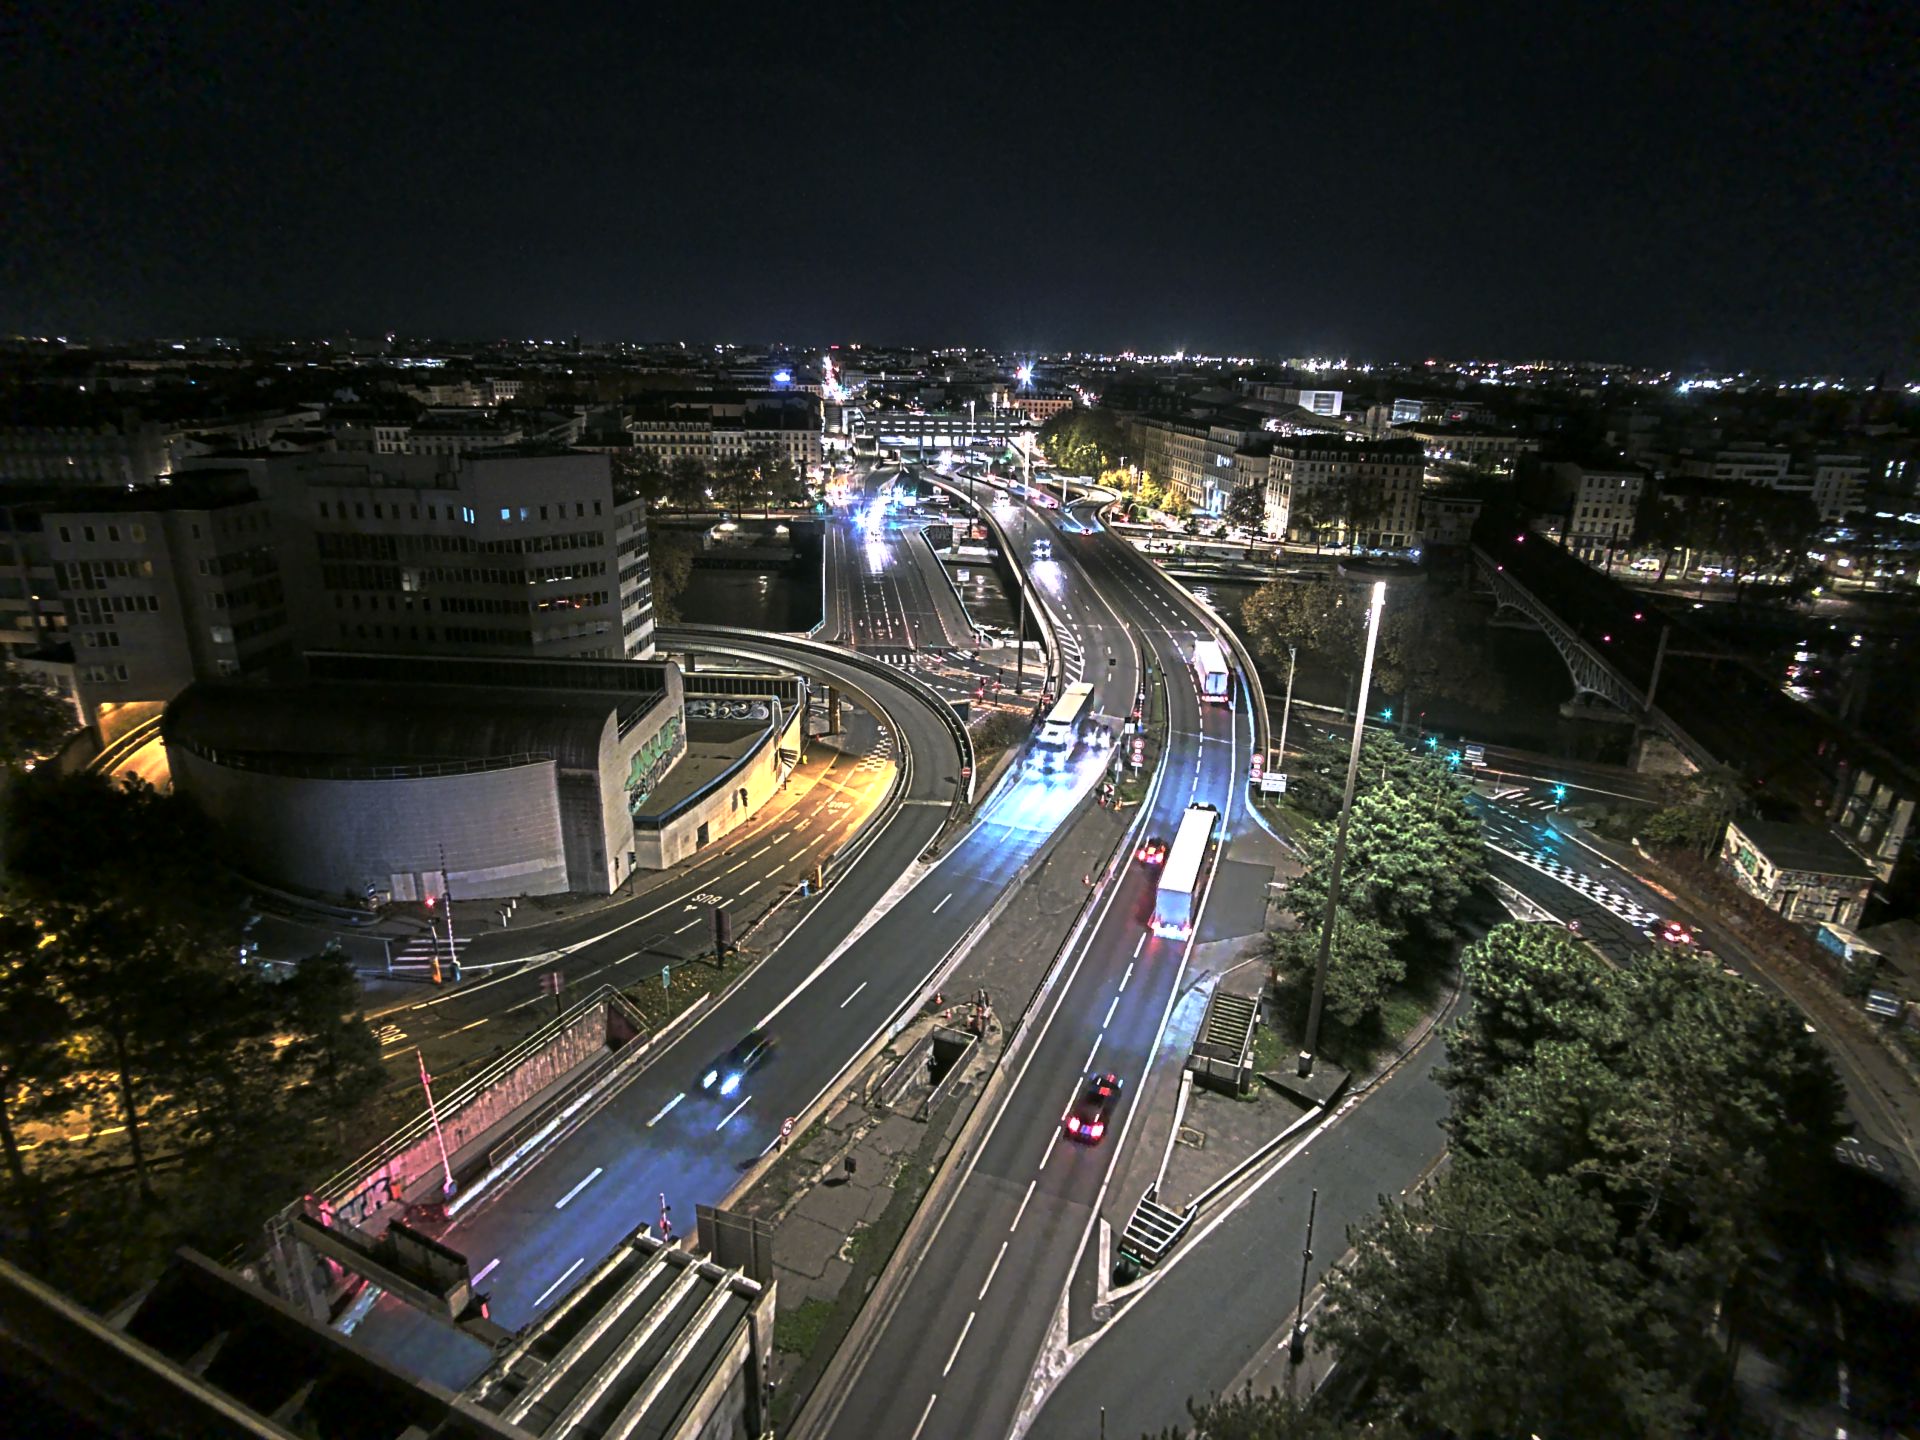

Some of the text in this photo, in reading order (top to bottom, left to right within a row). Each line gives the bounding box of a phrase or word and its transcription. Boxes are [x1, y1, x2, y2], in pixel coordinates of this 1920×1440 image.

[691, 893, 723, 905] BUS
[380, 1024, 408, 1046] BUS
[1835, 1146, 1885, 1173] BUS
